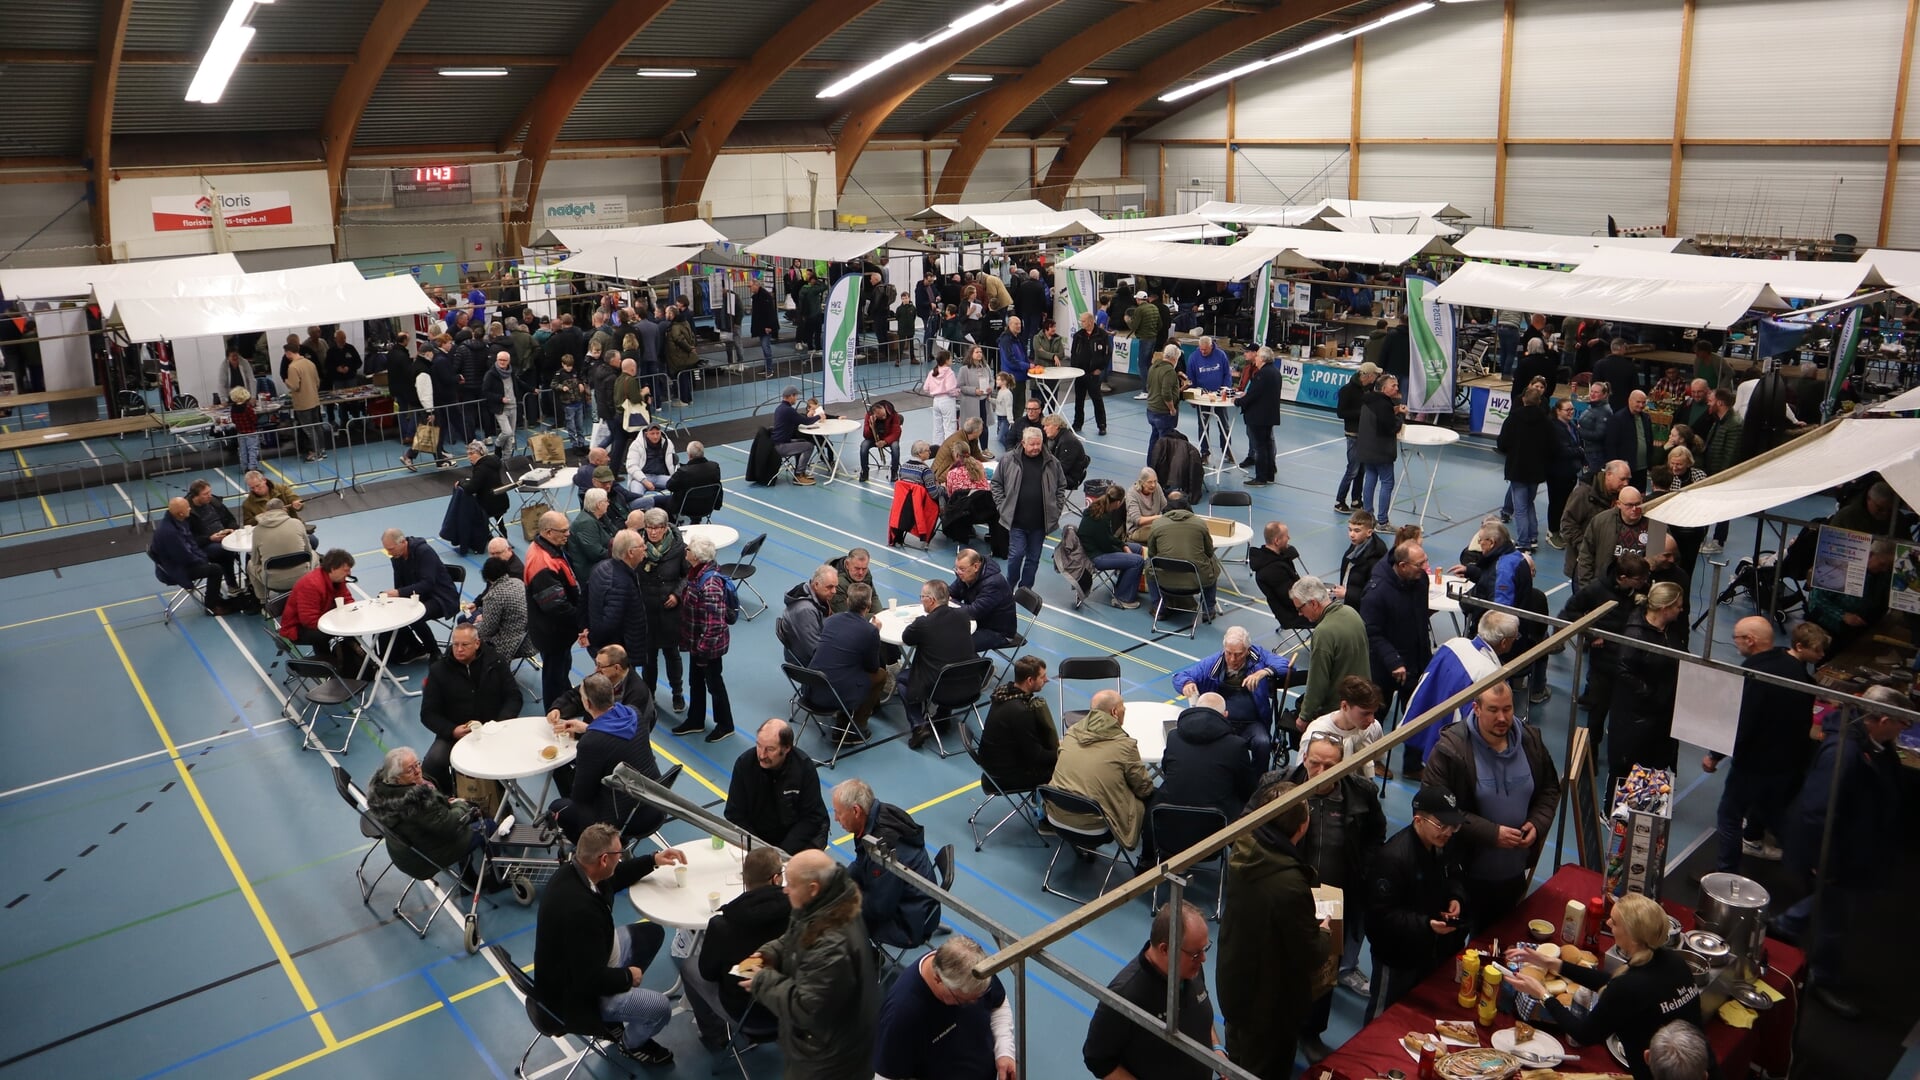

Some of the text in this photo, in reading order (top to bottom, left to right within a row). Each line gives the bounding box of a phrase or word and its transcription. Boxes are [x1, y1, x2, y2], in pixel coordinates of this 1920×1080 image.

[416, 167, 452, 181] 1143
[1283, 365, 1299, 376] HVZ
[1310, 369, 1352, 386] SPORTV
[1491, 397, 1510, 408] HVZ
